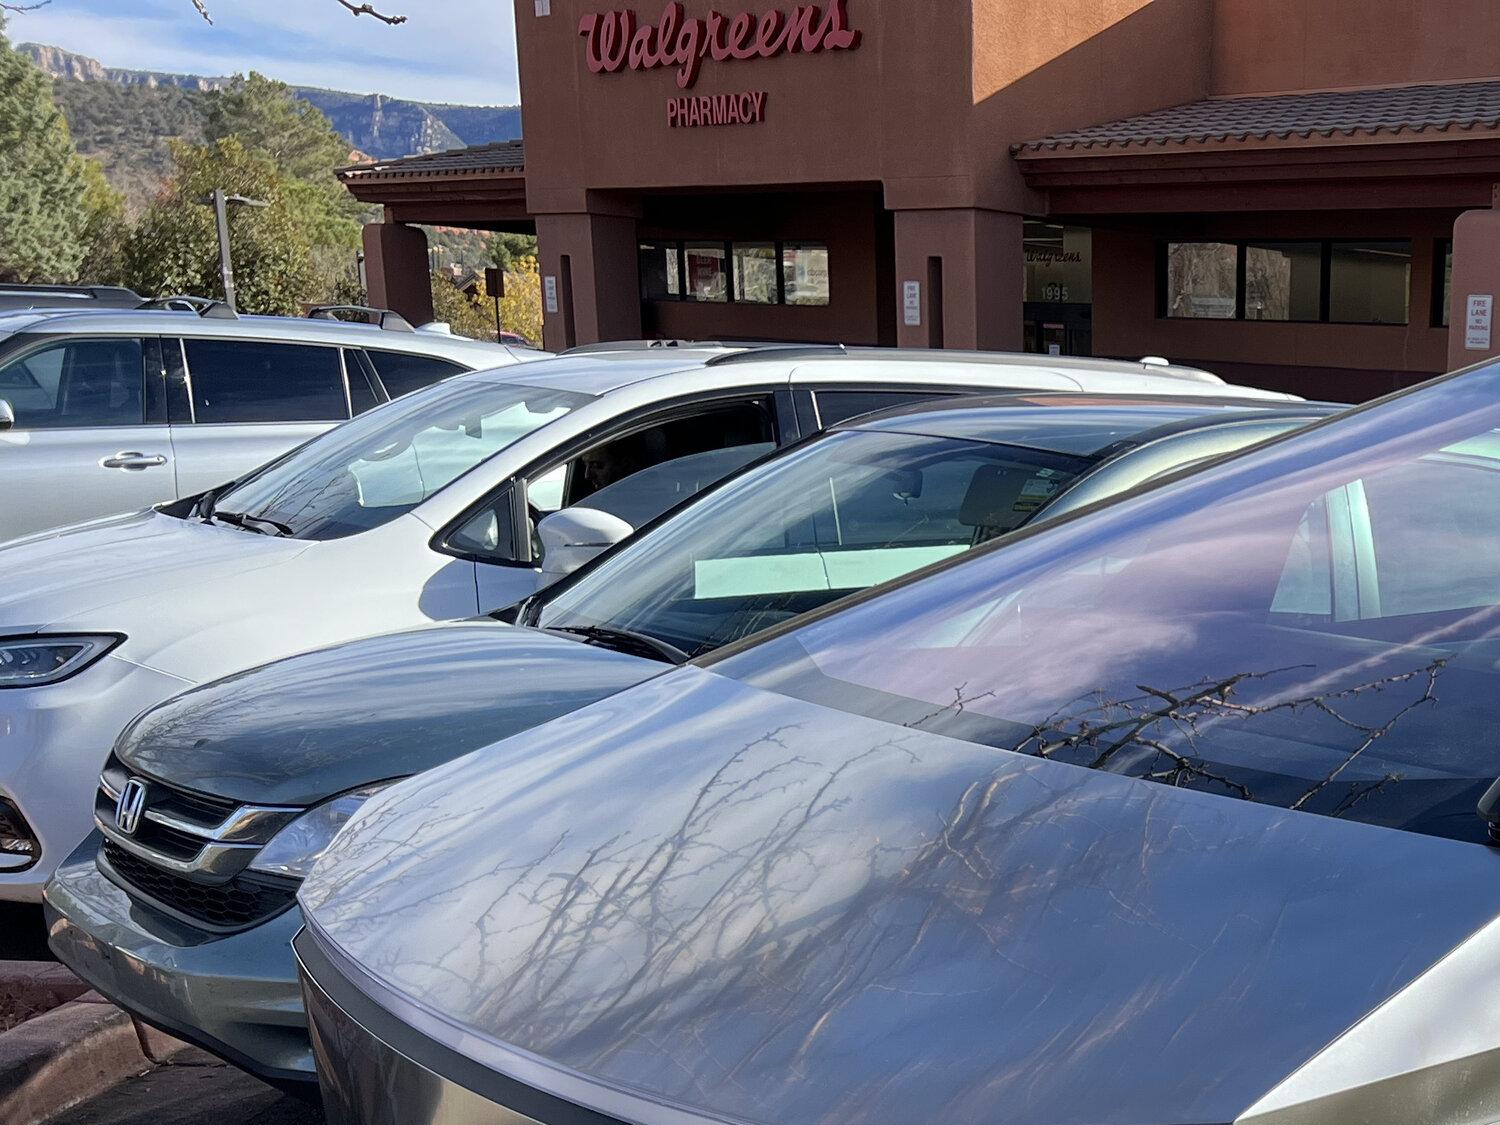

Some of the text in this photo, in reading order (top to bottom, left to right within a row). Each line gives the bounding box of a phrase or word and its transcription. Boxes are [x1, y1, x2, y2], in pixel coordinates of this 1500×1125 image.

[577, 0, 860, 89] Walgreens
[666, 91, 767, 127] PHARMACY
[1024, 249, 1082, 267] Walgreens
[1041, 286, 1070, 301] 1995
[1471, 309, 1488, 317] LANE
